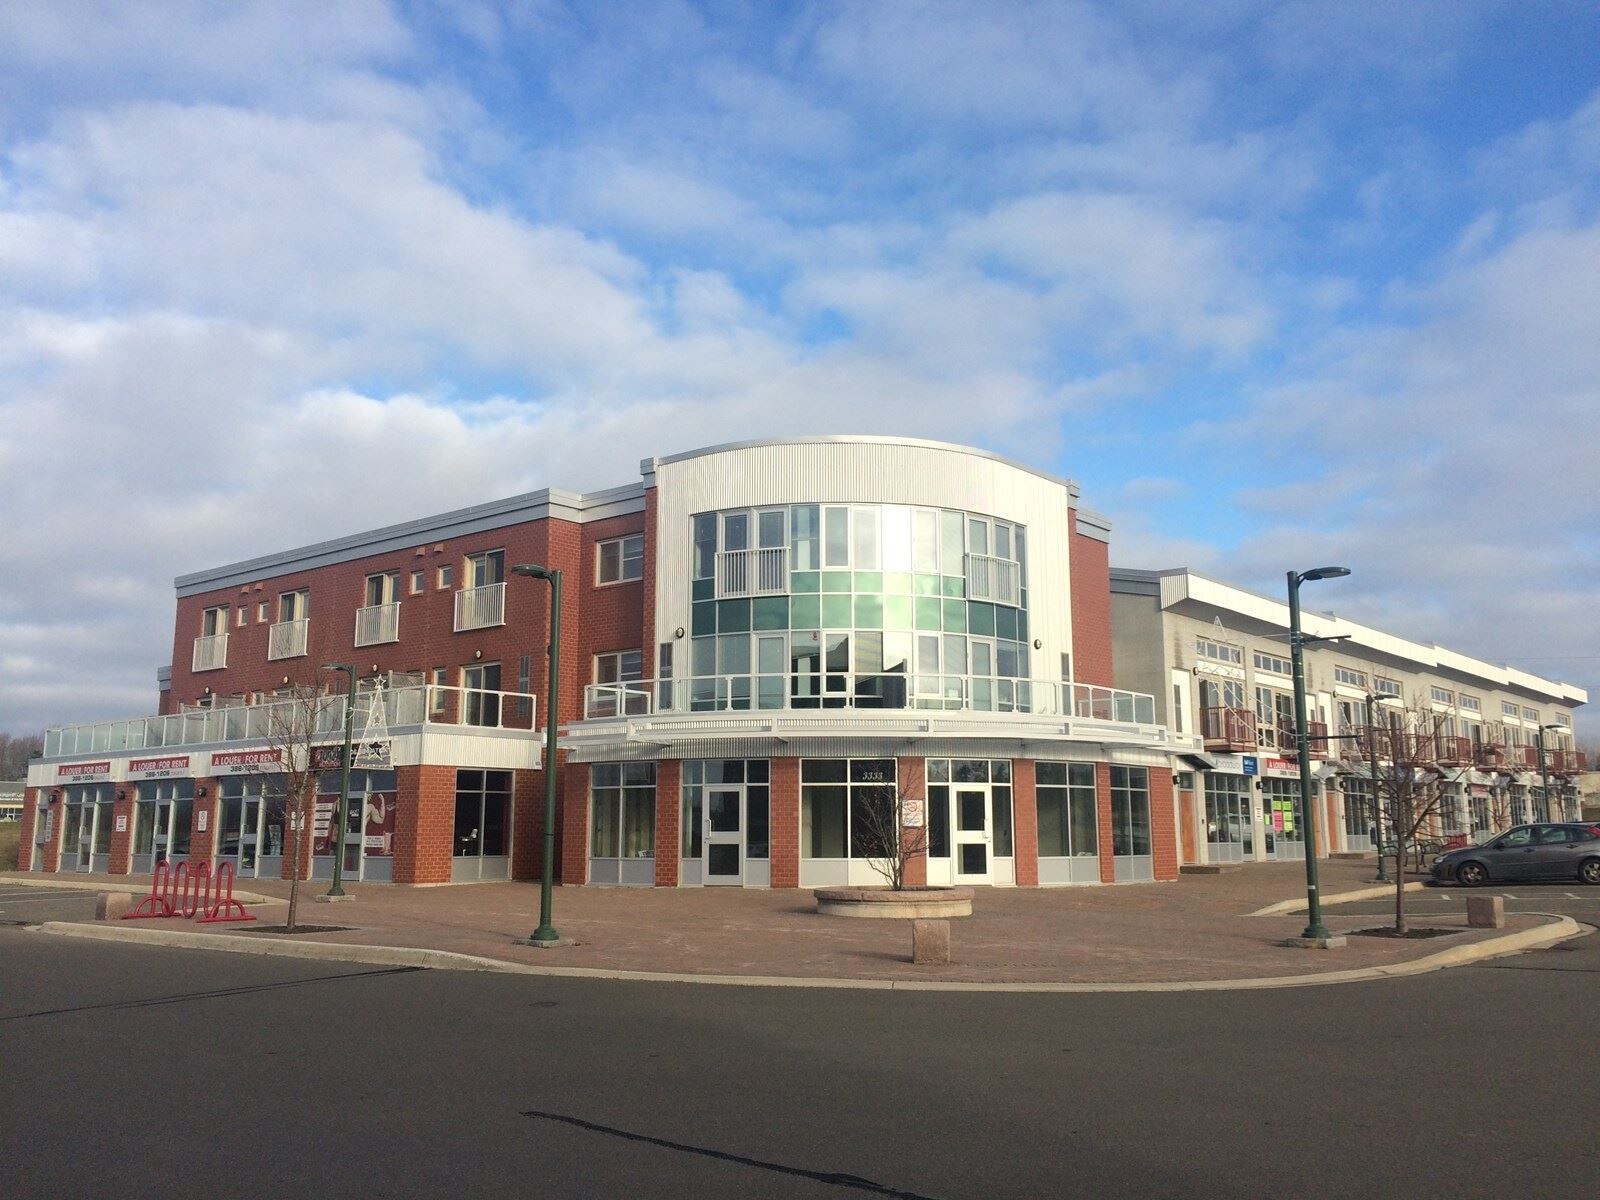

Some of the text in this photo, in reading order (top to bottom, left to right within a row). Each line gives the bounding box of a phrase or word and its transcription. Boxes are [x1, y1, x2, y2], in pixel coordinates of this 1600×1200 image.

[221, 756, 241, 765] LOUER
[245, 755, 259, 763] FOR
[259, 754, 277, 762] RENT
[66, 767, 81, 775] LOUER
[84, 766, 94, 774] FOR
[95, 765, 108, 773] RENT
[138, 762, 156, 771] LOUER
[159, 760, 170, 769] FOR
[171, 760, 187, 768] RENT
[862, 771, 883, 780] 3333
